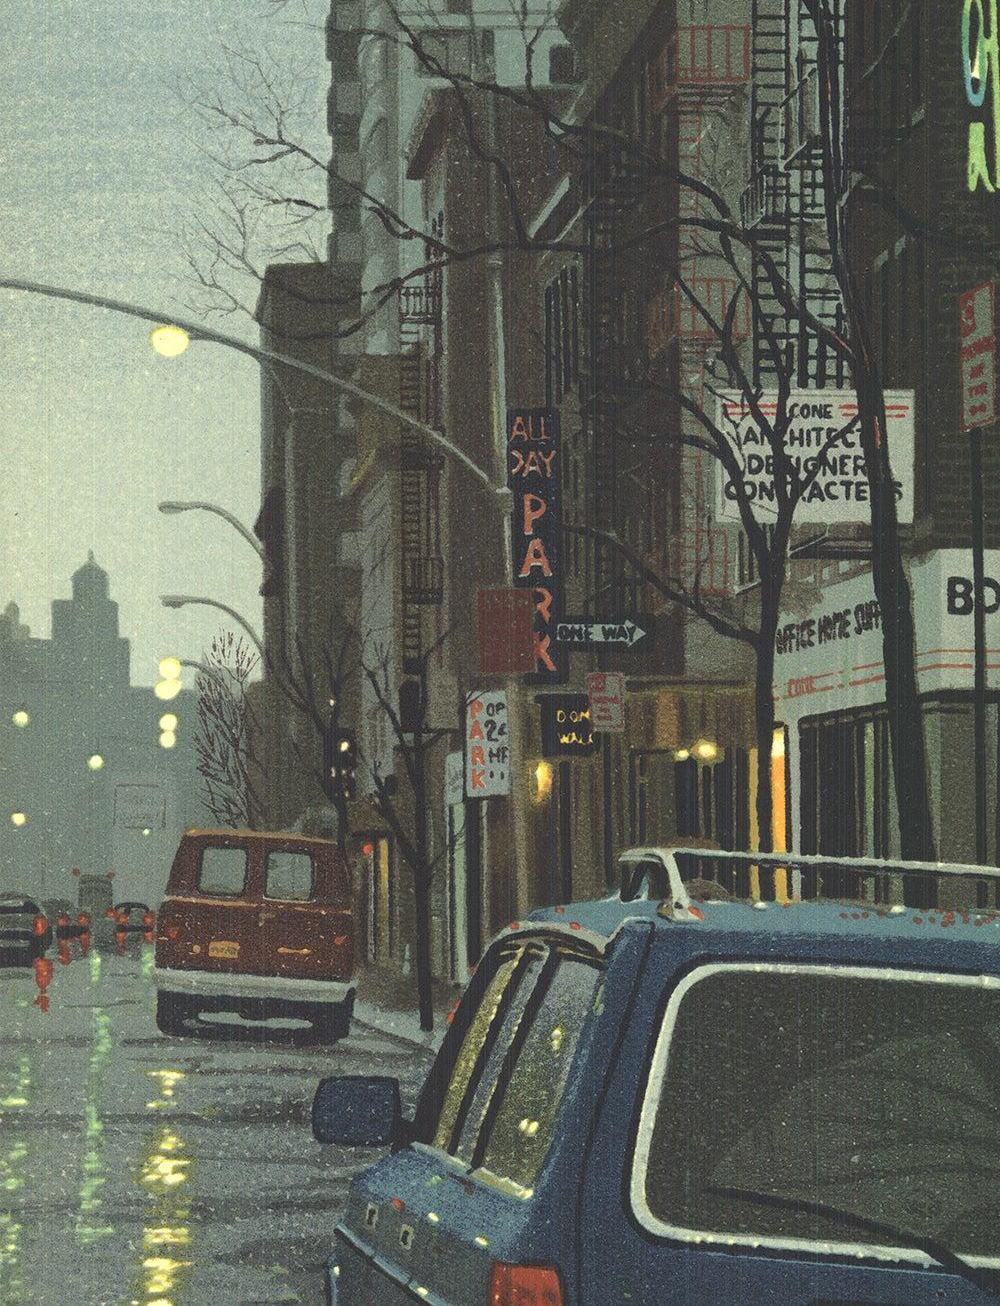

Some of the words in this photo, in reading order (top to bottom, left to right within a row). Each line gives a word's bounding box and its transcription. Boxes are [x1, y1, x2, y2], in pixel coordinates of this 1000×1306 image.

[790, 403, 833, 419] CONE
[509, 416, 550, 442] ALL
[511, 450, 556, 477] DAY
[601, 623, 636, 643] WAY
[469, 698, 486, 790] PARK
